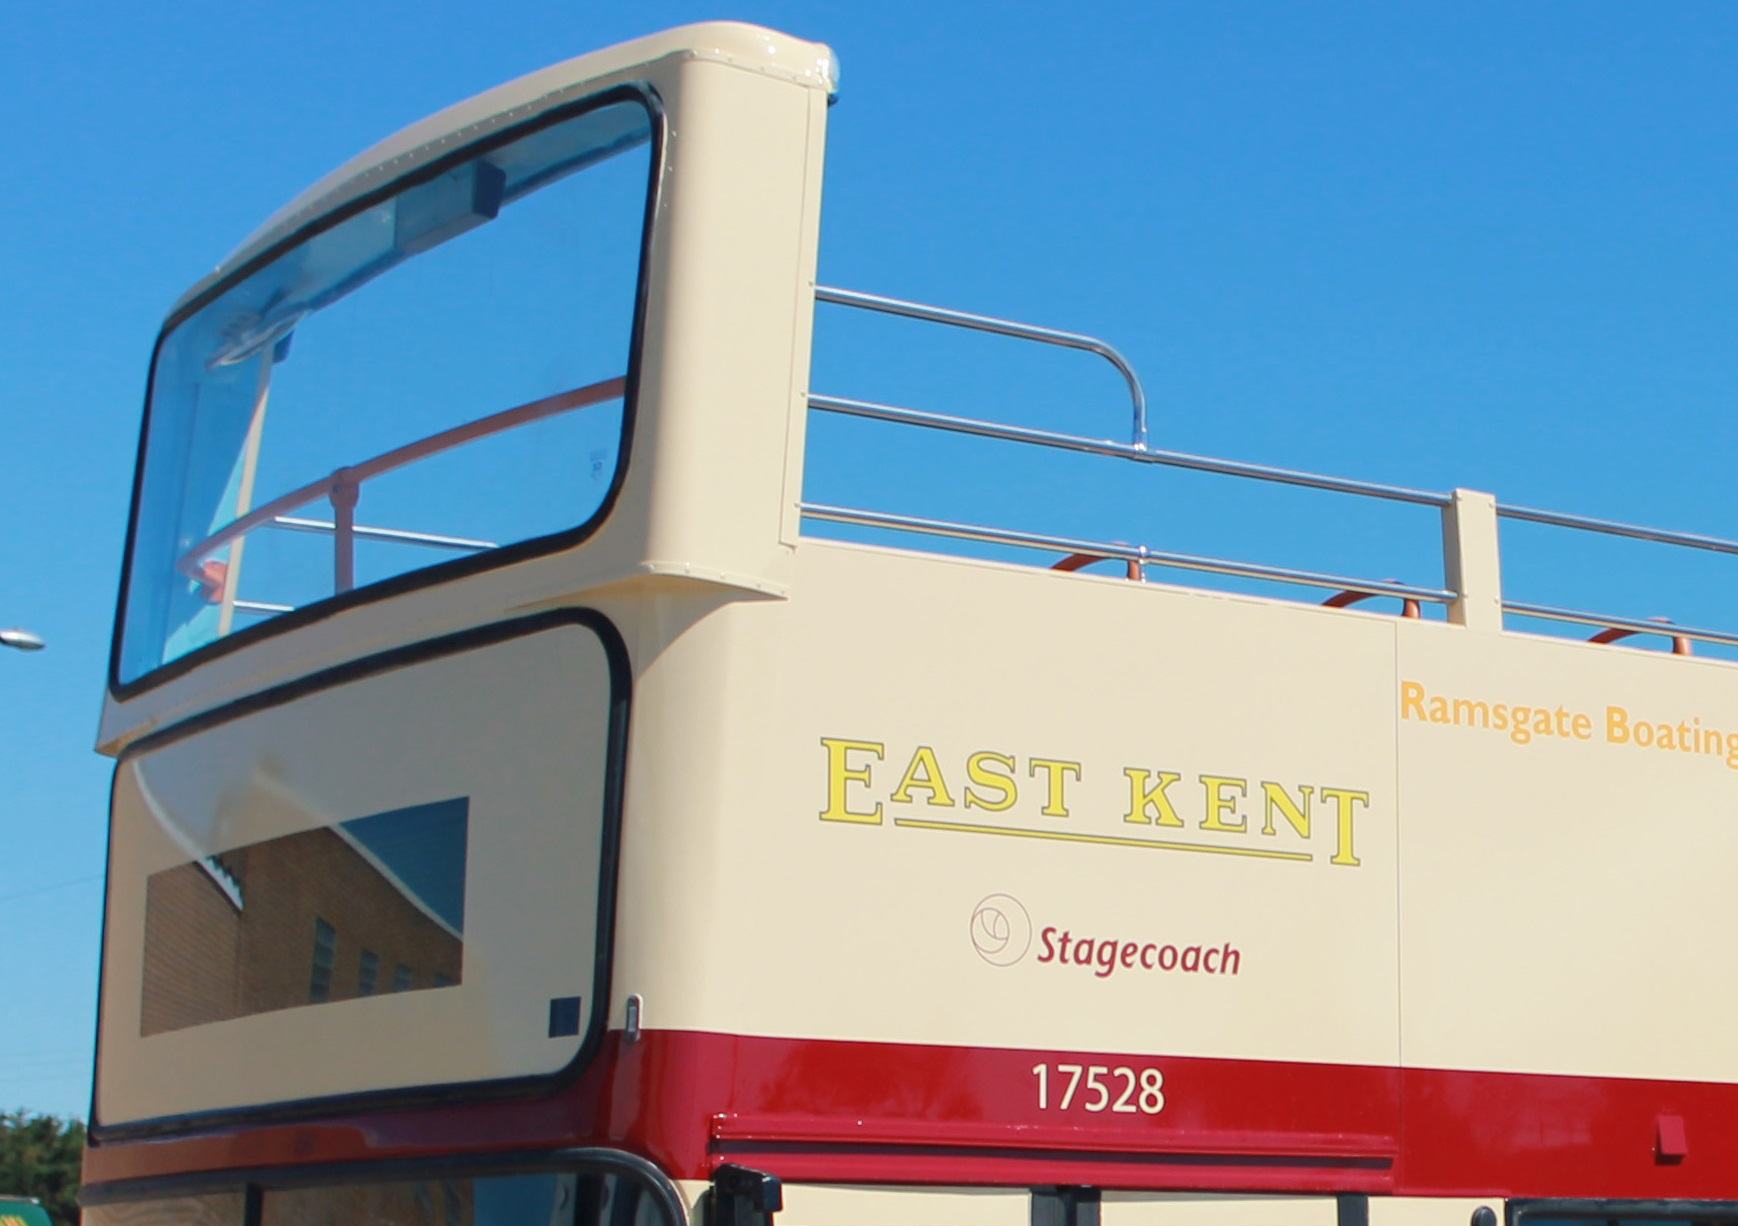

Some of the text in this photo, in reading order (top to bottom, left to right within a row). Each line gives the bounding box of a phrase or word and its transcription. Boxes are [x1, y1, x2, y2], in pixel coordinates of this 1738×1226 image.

[1401, 680, 1592, 745] Ramsgate
[819, 737, 1369, 866] EAST KENT
[1037, 926, 1241, 978] Stagecoach
[1032, 1063, 1165, 1114] 17528
